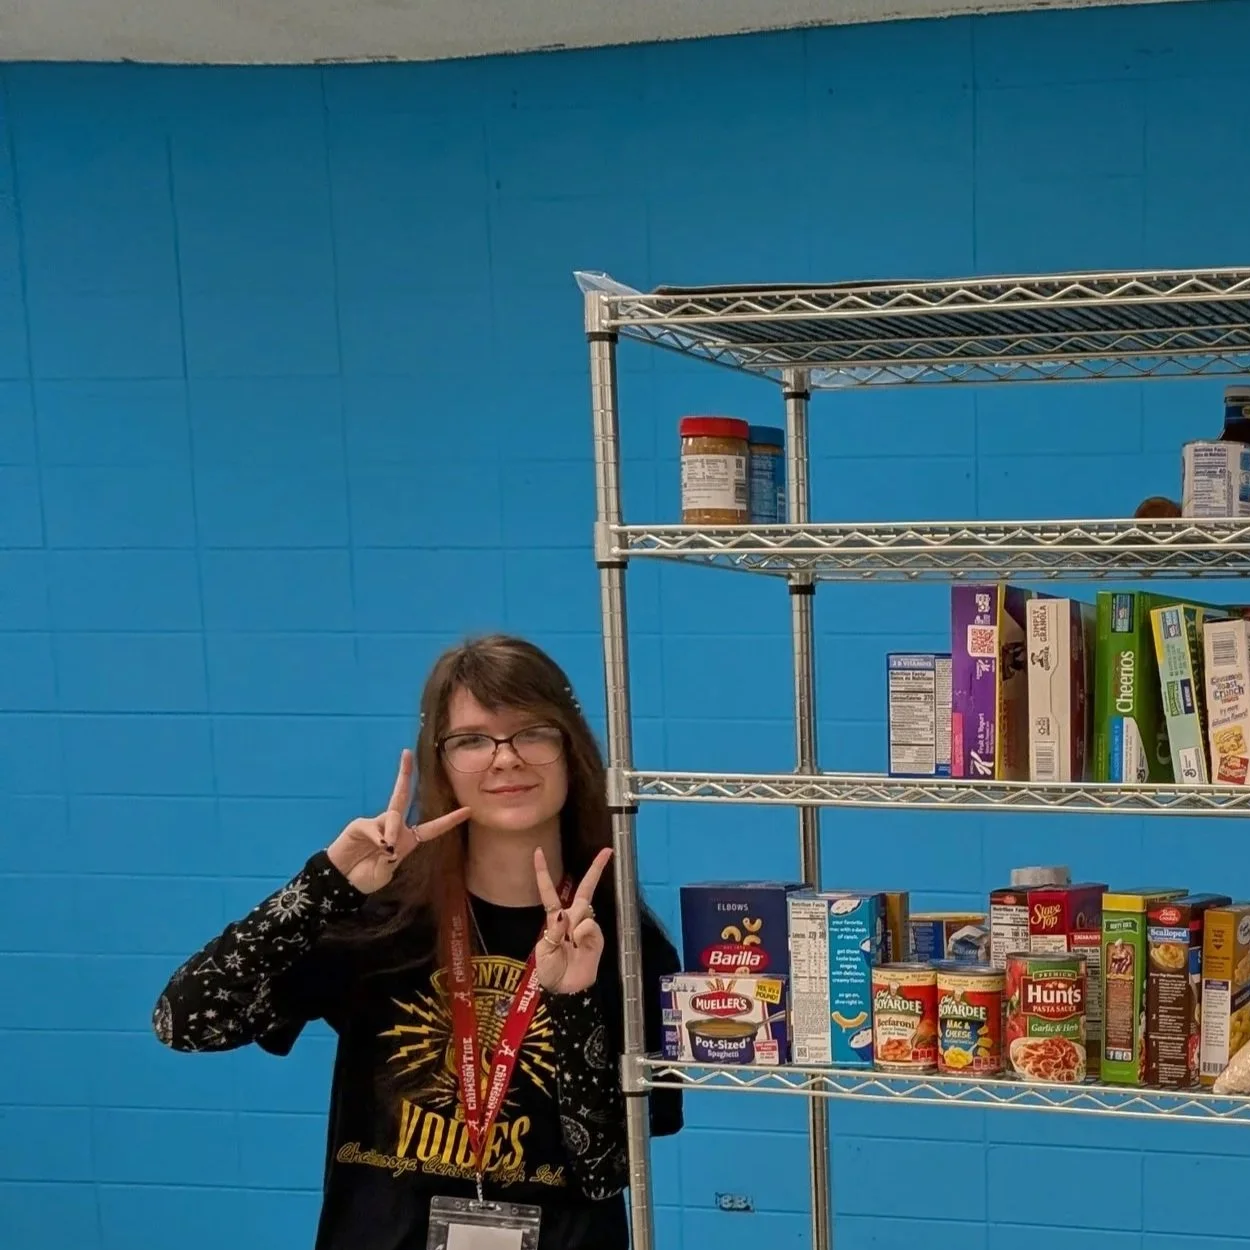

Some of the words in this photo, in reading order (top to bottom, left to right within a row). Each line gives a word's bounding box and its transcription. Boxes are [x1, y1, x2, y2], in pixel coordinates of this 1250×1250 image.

[1033, 609, 1041, 638] SIMPLY
[1039, 604, 1048, 642] GRANOLA
[1115, 650, 1135, 713] Cheerios
[1213, 685, 1244, 700] Crunch
[717, 903, 749, 912] ELBOWS
[1031, 903, 1062, 925] Stove
[1041, 914, 1058, 930] Top
[1150, 929, 1187, 940] Scalloped
[709, 950, 762, 967] Barilla
[1027, 984, 1082, 1004] Hunt's
[695, 997, 747, 1011] MUELLER'S
[874, 998, 923, 1015] BOYARDEE
[938, 1003, 987, 1019] BOYARDEE
[1032, 1005, 1055, 1013] PASTA
[1056, 1005, 1077, 1013] SAUCE
[877, 1018, 915, 1030] Beefaroni
[946, 1019, 963, 1029] MAC
[1031, 1023, 1056, 1033] Garlic
[1056, 1024, 1062, 1032] &
[1063, 1024, 1079, 1032] Herb
[945, 1030, 972, 1039] CHEESE
[462, 1036, 475, 1064] TIDE
[695, 1036, 746, 1051] Pot-Sized
[707, 1049, 740, 1059] Spaghetti
[462, 1064, 477, 1111] CRIMSON
[487, 1064, 507, 1110] CRIMSON
